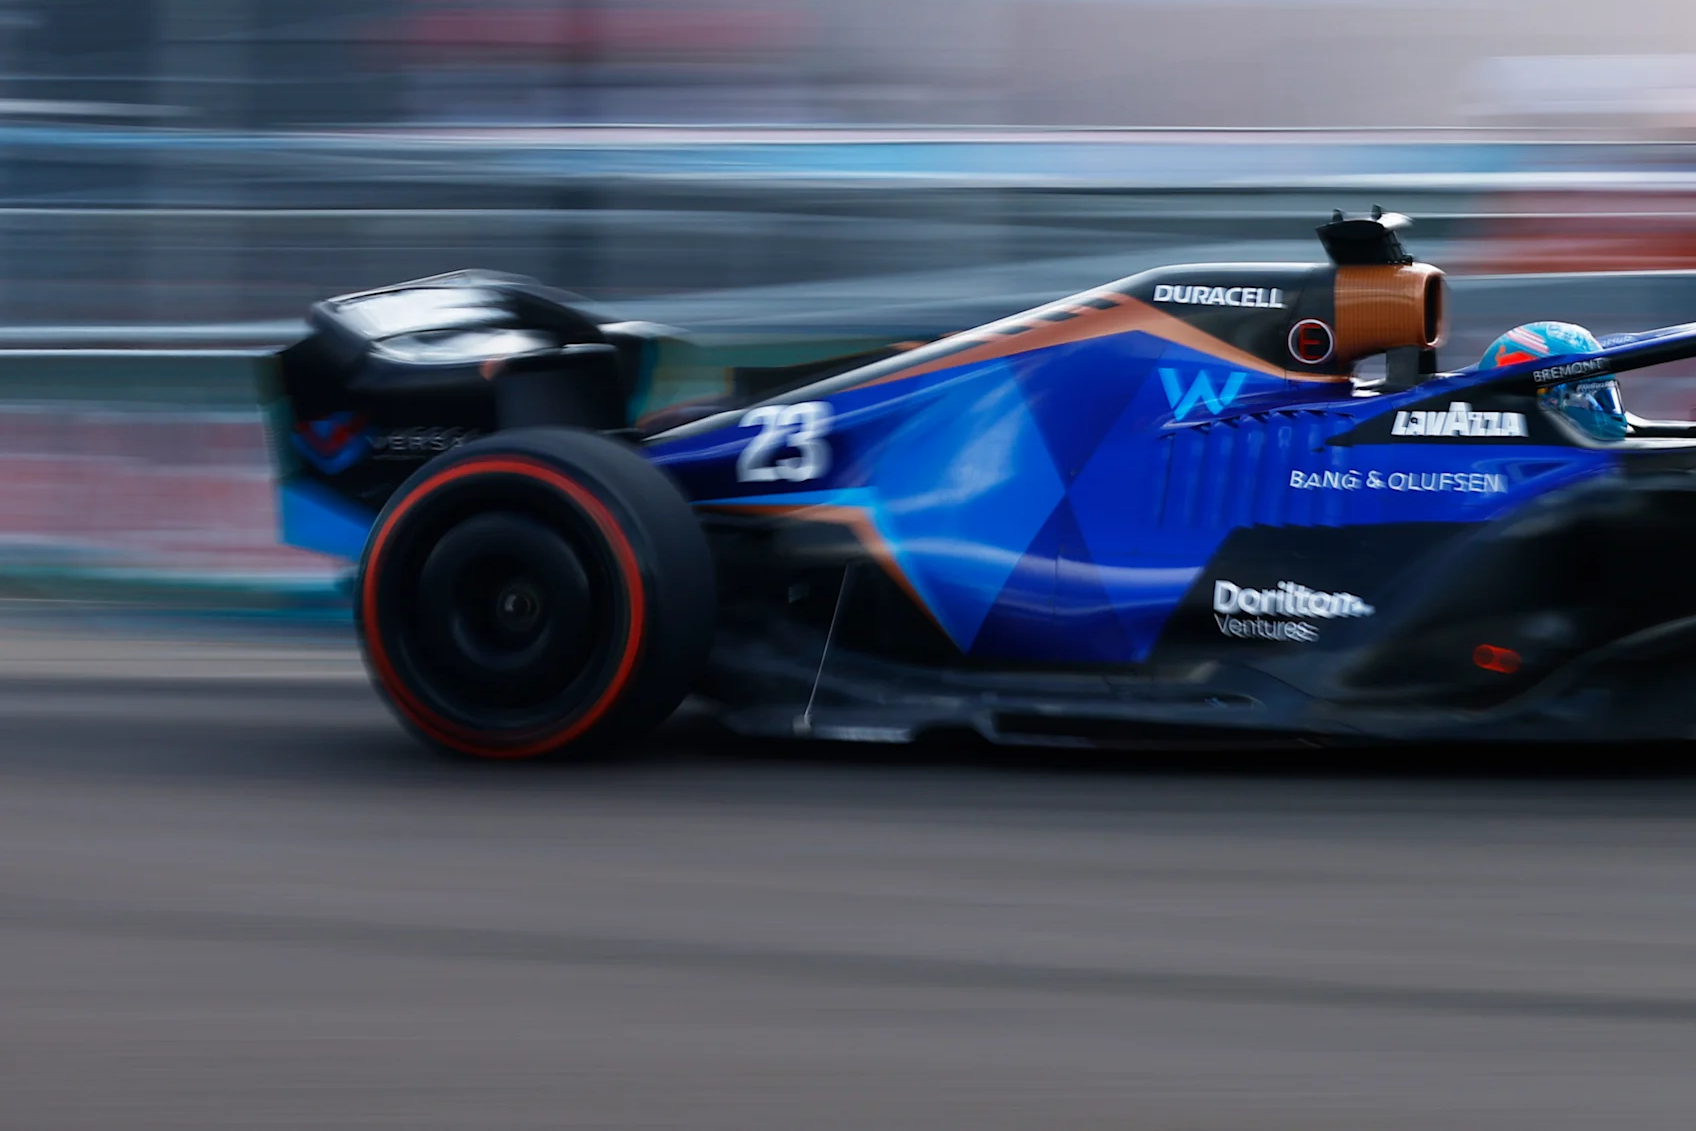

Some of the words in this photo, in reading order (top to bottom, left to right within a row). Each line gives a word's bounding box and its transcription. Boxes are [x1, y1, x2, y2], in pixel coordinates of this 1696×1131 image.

[1153, 284, 1286, 309] DURACELL
[1299, 323, 1323, 361] E
[1533, 357, 1608, 383] BREMONT
[1391, 401, 1528, 437] LAVAZZA
[736, 400, 834, 482] 23
[1289, 470, 1362, 490] BANG
[1365, 470, 1386, 489] &
[1387, 472, 1507, 493] OLUFSEN
[1213, 579, 1364, 619] Dorilton
[1214, 613, 1320, 642] Ventures
